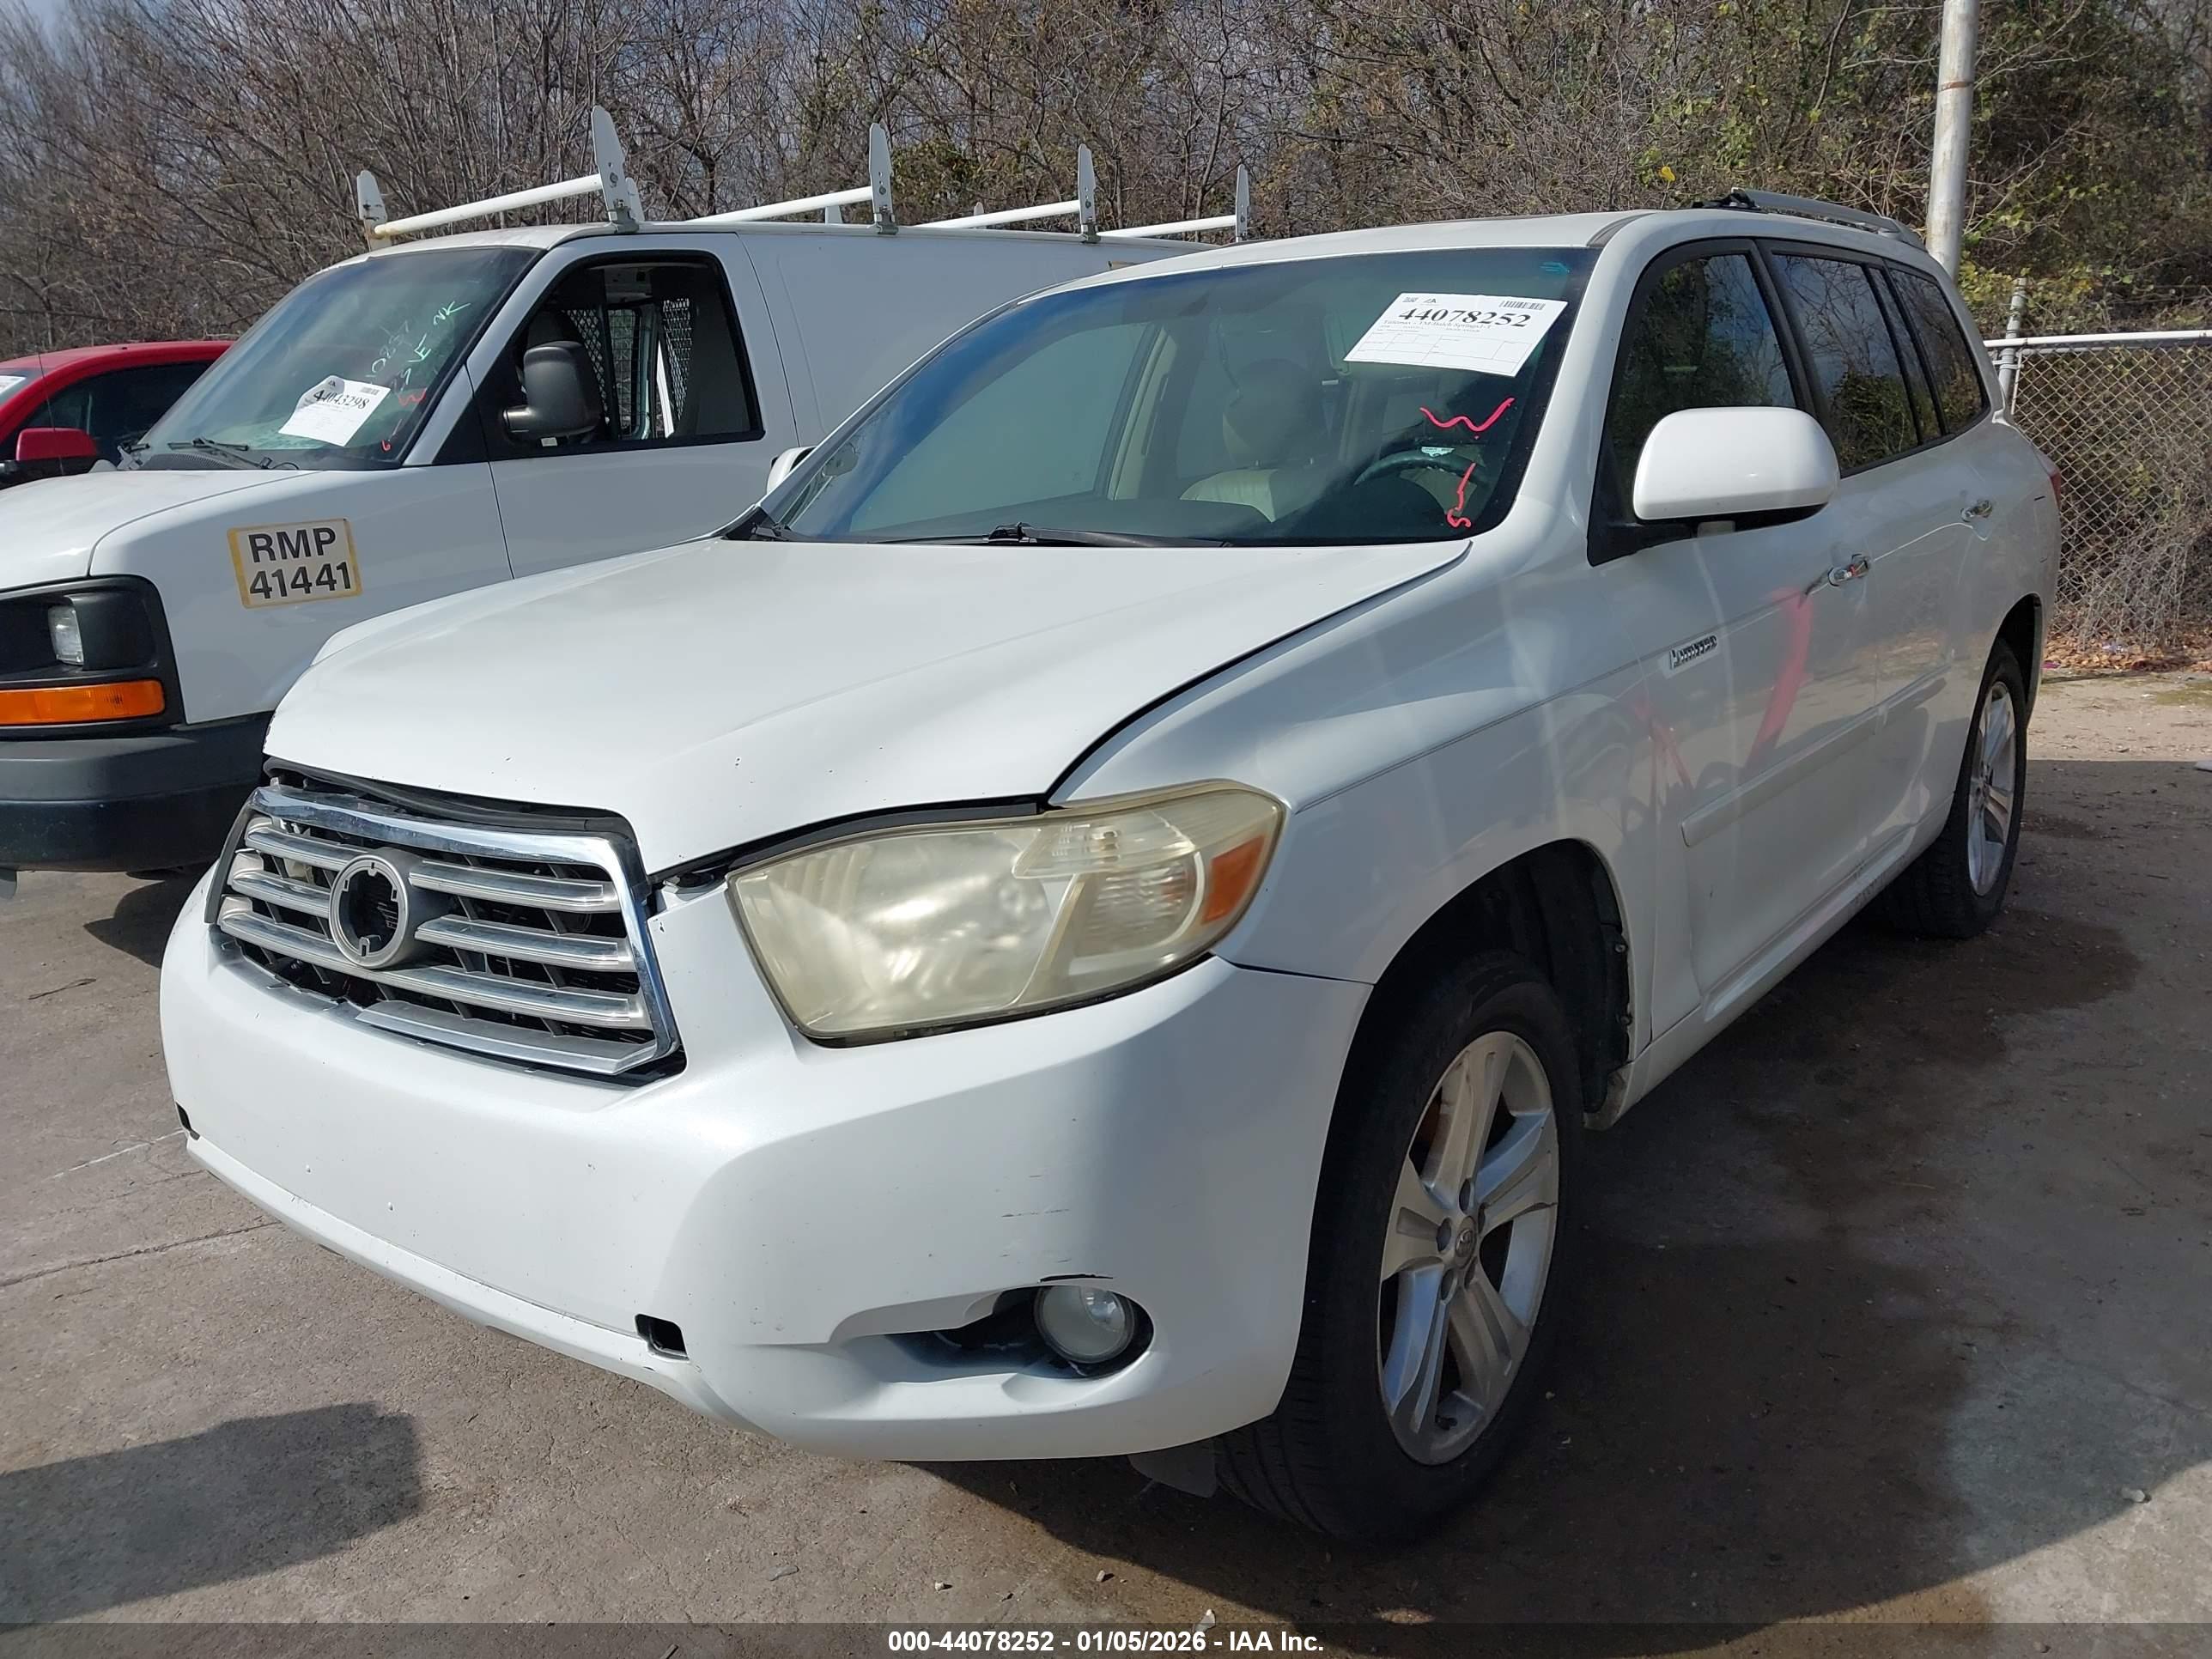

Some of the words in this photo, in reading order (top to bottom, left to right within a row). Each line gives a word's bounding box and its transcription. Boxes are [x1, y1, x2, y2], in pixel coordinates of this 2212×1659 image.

[1399, 307, 1532, 328] 44078252
[248, 526, 336, 563] RMP
[249, 561, 351, 599] 41441
